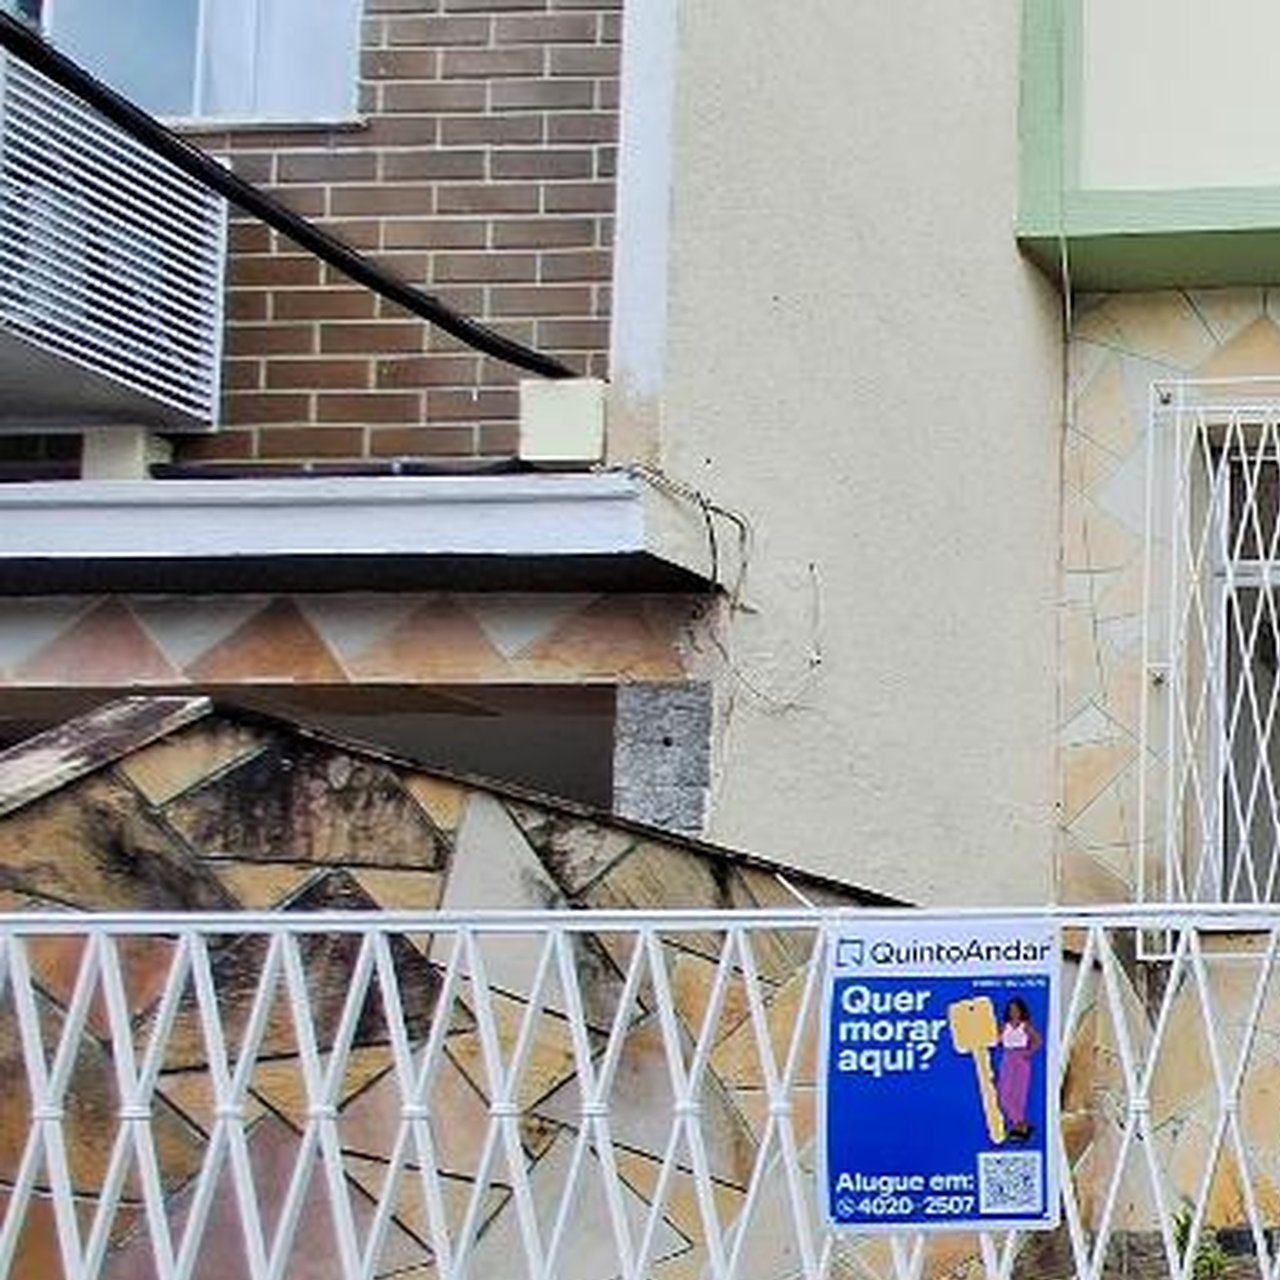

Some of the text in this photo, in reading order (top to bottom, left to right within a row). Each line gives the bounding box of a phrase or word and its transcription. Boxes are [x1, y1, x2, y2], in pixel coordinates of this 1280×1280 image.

[870, 939, 1050, 965] QuintoAndar
[842, 986, 931, 1014] Quer
[838, 1018, 947, 1042] morar
[838, 1042, 936, 1077] aqui?
[836, 1173, 974, 1197] Alugue em:
